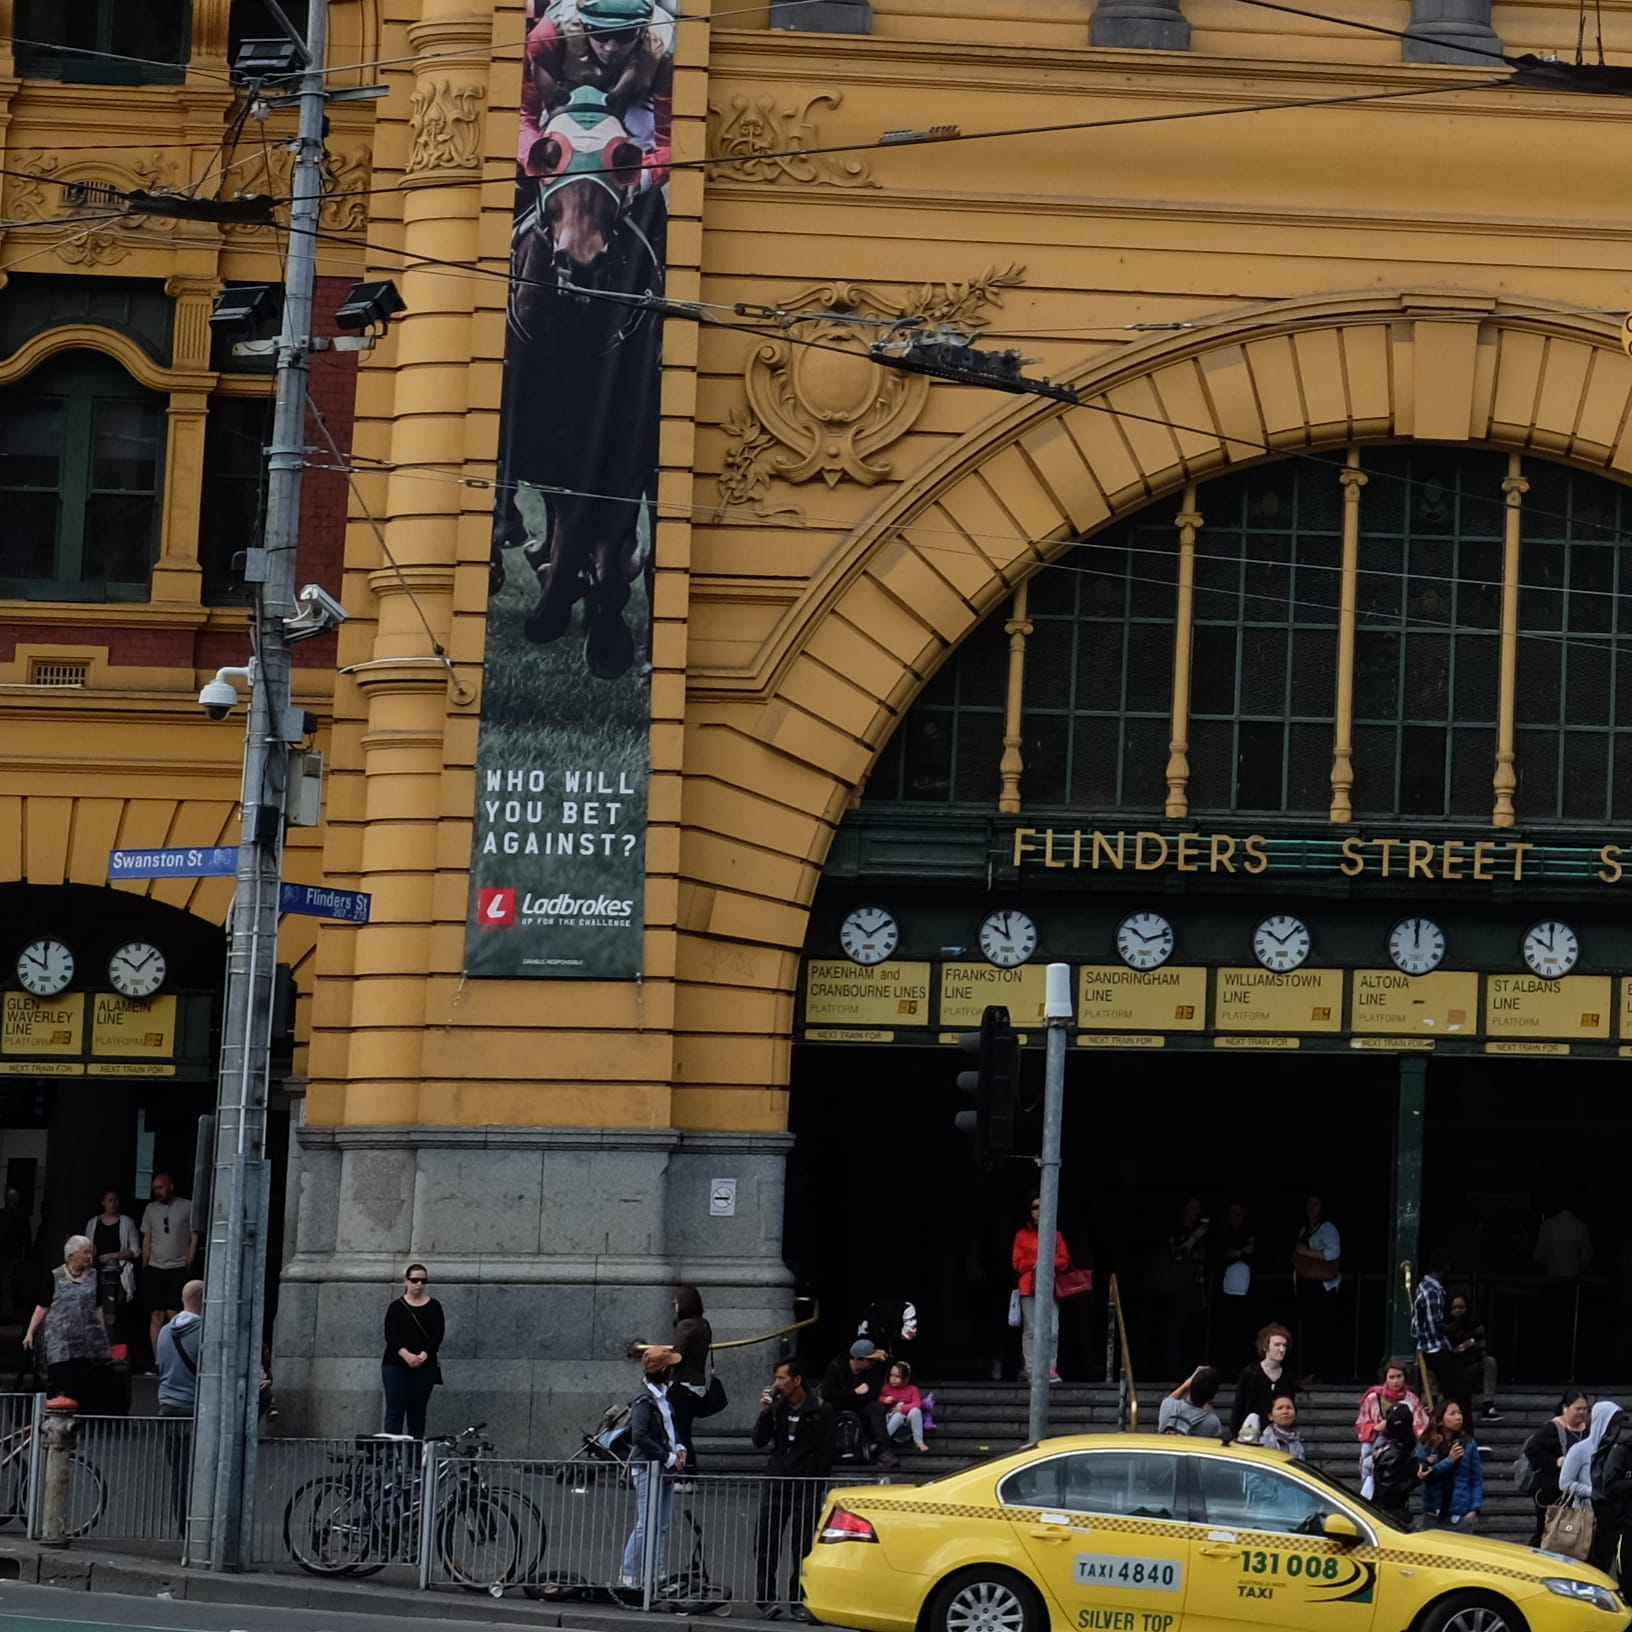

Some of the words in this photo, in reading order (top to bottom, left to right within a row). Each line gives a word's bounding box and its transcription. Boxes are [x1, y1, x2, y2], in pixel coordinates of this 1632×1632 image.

[486, 770, 544, 792] WHO
[565, 771, 634, 794] WILL
[485, 801, 542, 823] YOU
[562, 801, 621, 824] BET
[483, 832, 636, 856] AGAINST?
[113, 852, 184, 868] Swanston
[187, 850, 203, 866] St
[1013, 828, 1269, 874] FLINDERS
[1339, 836, 1534, 881] STREET
[306, 888, 352, 909] Flinders
[355, 894, 368, 911] St
[522, 893, 633, 917] Ladbrokes
[579, 919, 631, 927] CHALLENGE
[811, 966, 874, 980] PAKENHAM
[880, 968, 900, 980] and
[945, 968, 1022, 983] FRANKSTON
[1086, 971, 1180, 986] SANDRINGHAM
[1224, 973, 1321, 988] WILLIAMSTOWN
[1360, 975, 1409, 989] ALTONA
[1493, 980, 1509, 992] ST
[1512, 980, 1561, 993] ALBANS
[810, 983, 890, 998] CRANBOURNE
[894, 985, 926, 999] LINES
[944, 986, 973, 999] LINE
[1085, 989, 1112, 1002] LINE
[1223, 991, 1250, 1004] LINE
[7, 998, 40, 1011] GLEN
[1359, 993, 1386, 1006] LINE
[1493, 997, 1520, 1010] LINE
[99, 1000, 151, 1013] ALAMEIN
[810, 1003, 858, 1014] PLATFORM
[7, 1011, 73, 1024] WAVERLEY
[96, 1013, 123, 1025] LINE
[1084, 1008, 1132, 1019] PLATFORM
[1222, 1010, 1270, 1020] PLATFORM
[1358, 1014, 1406, 1024] PLATFORM
[1492, 1017, 1539, 1027] PLATFORM
[5, 1023, 33, 1035] LINE
[1241, 1550, 1279, 1574] 131
[1286, 1554, 1338, 1580] 008
[1080, 1562, 1113, 1578] TAXI
[1118, 1561, 1174, 1585] 4840
[1237, 1586, 1273, 1599] TAXI
[1078, 1609, 1135, 1631] SILVER
[1142, 1613, 1173, 1632] TOP
